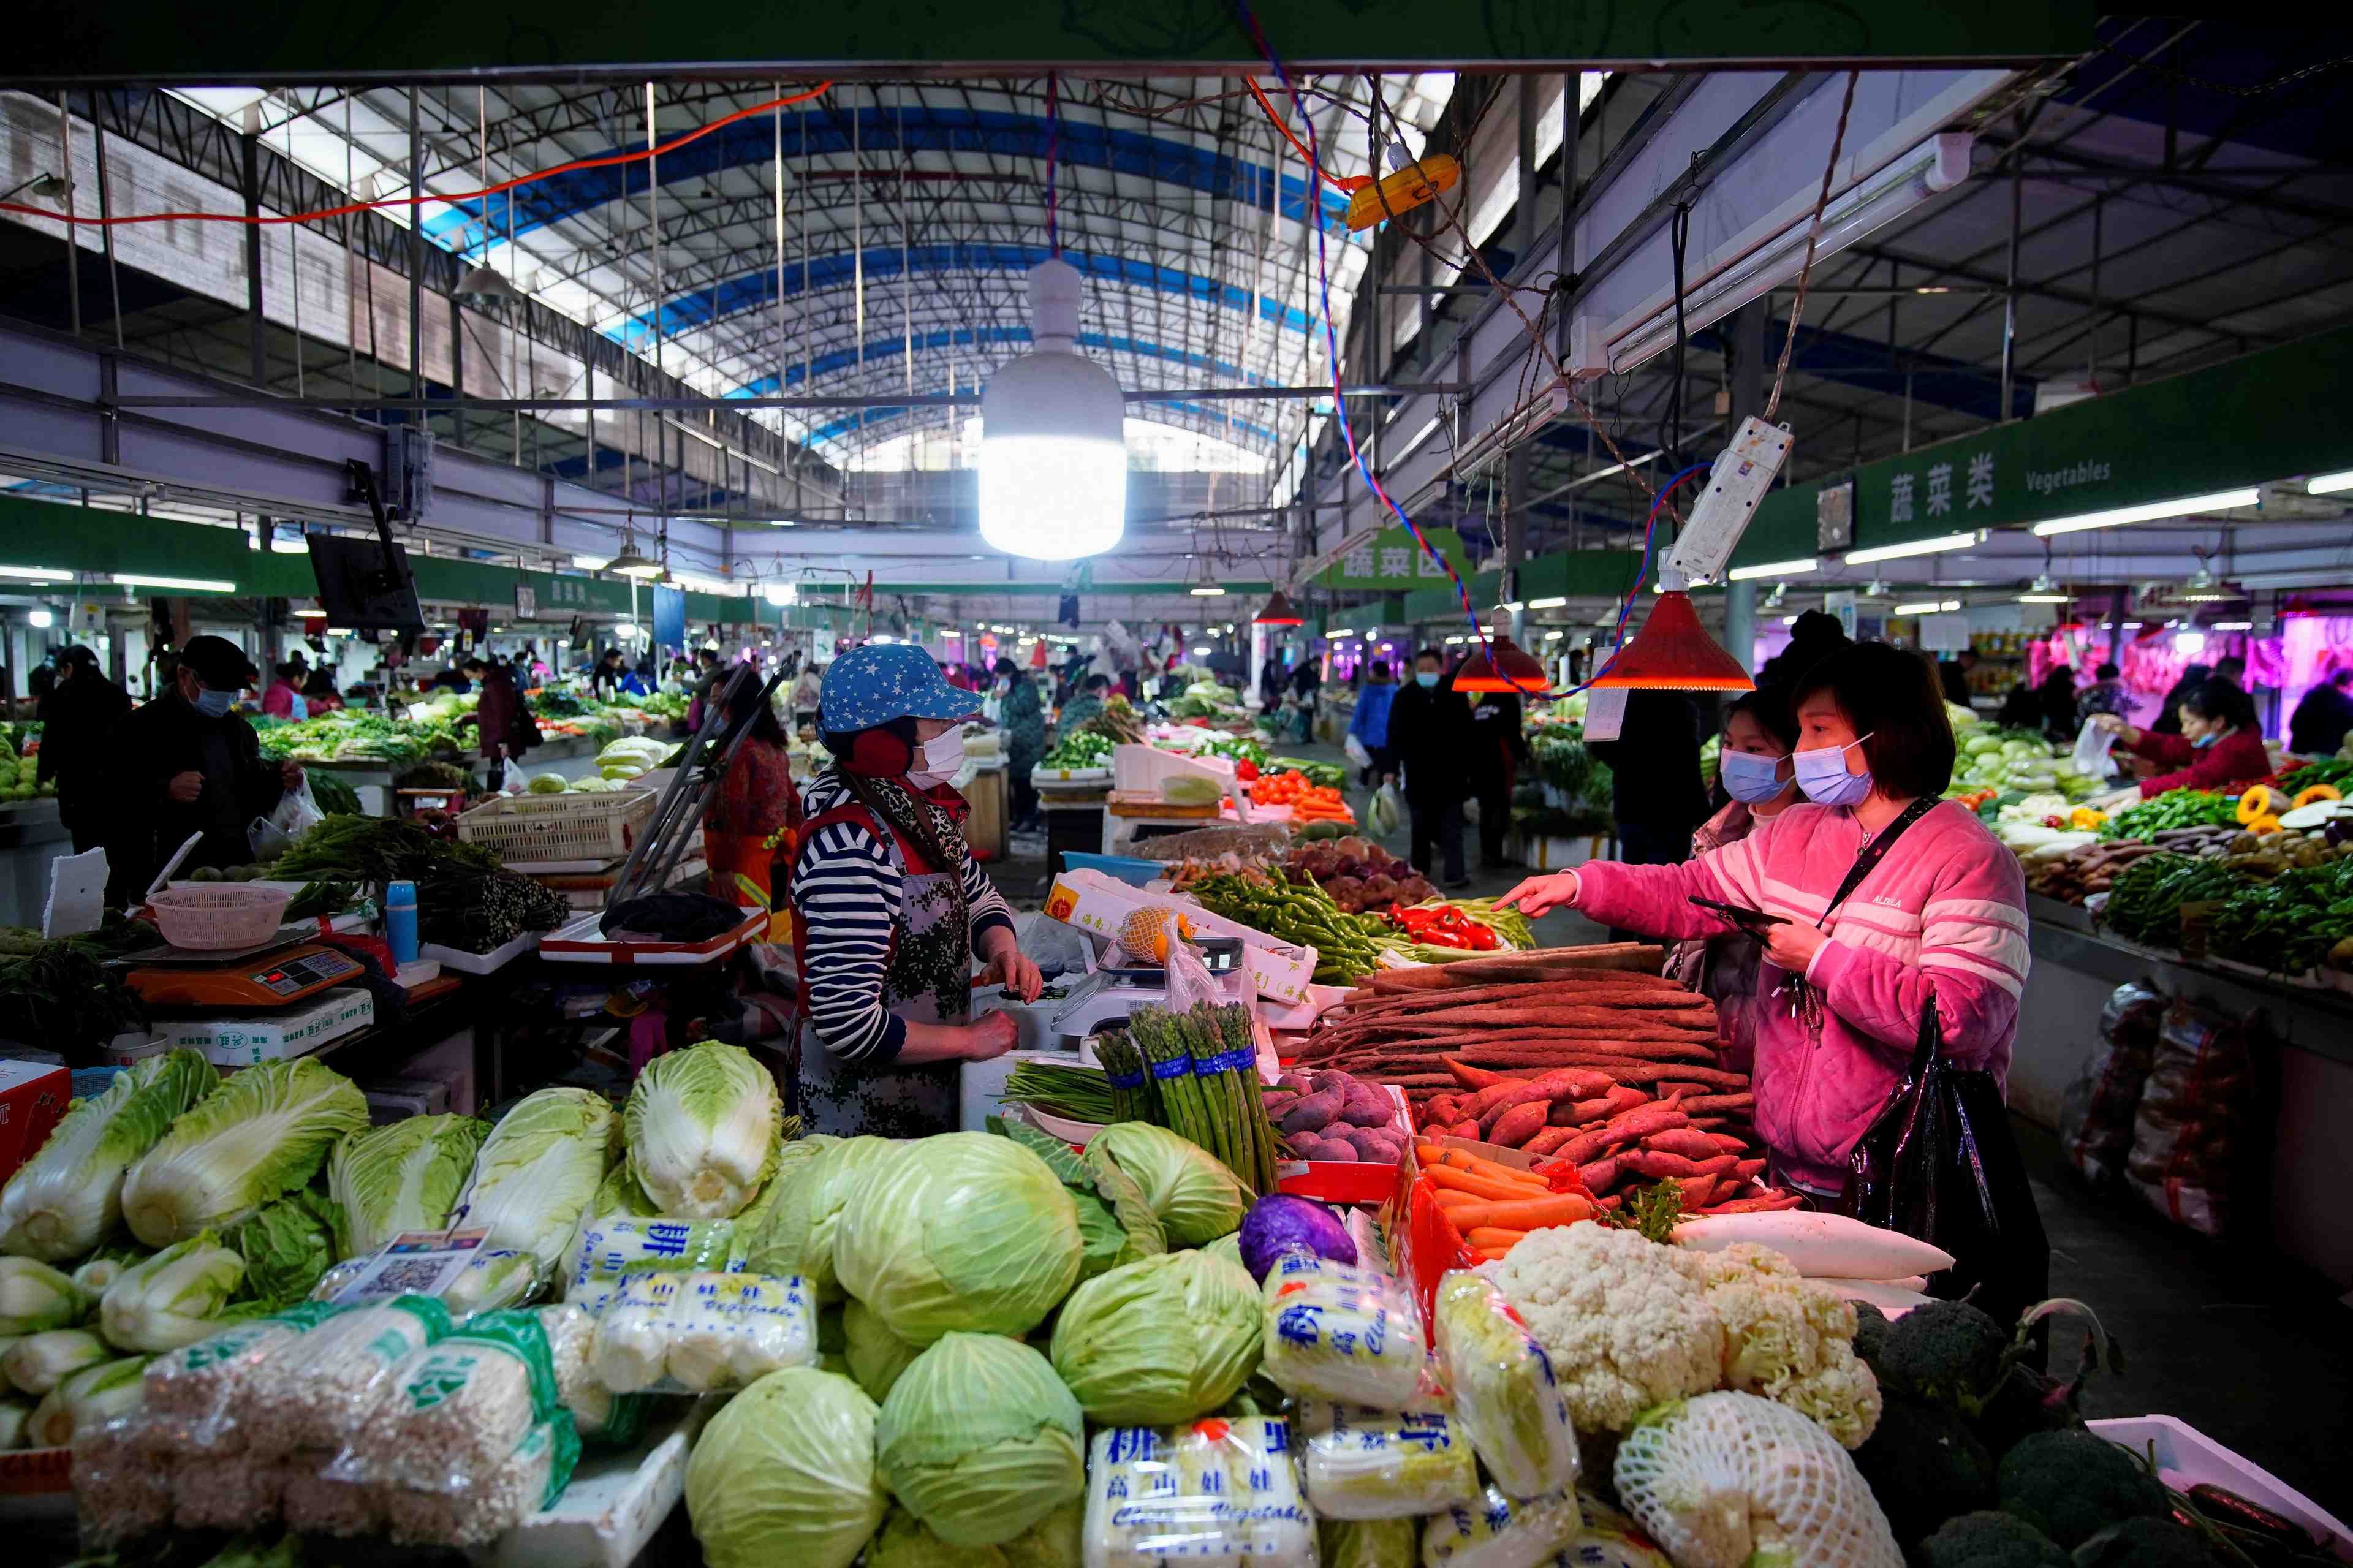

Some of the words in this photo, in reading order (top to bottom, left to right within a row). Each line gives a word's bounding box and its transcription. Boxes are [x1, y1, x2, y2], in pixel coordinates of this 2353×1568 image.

[1890, 452, 1995, 523] 蔬菜类
[2026, 459, 2111, 495] Vegetables
[1343, 547, 1448, 578] 蔬菜区
[219, 1034, 244, 1047] 兴旺
[1398, 1411, 1451, 1452] 野
